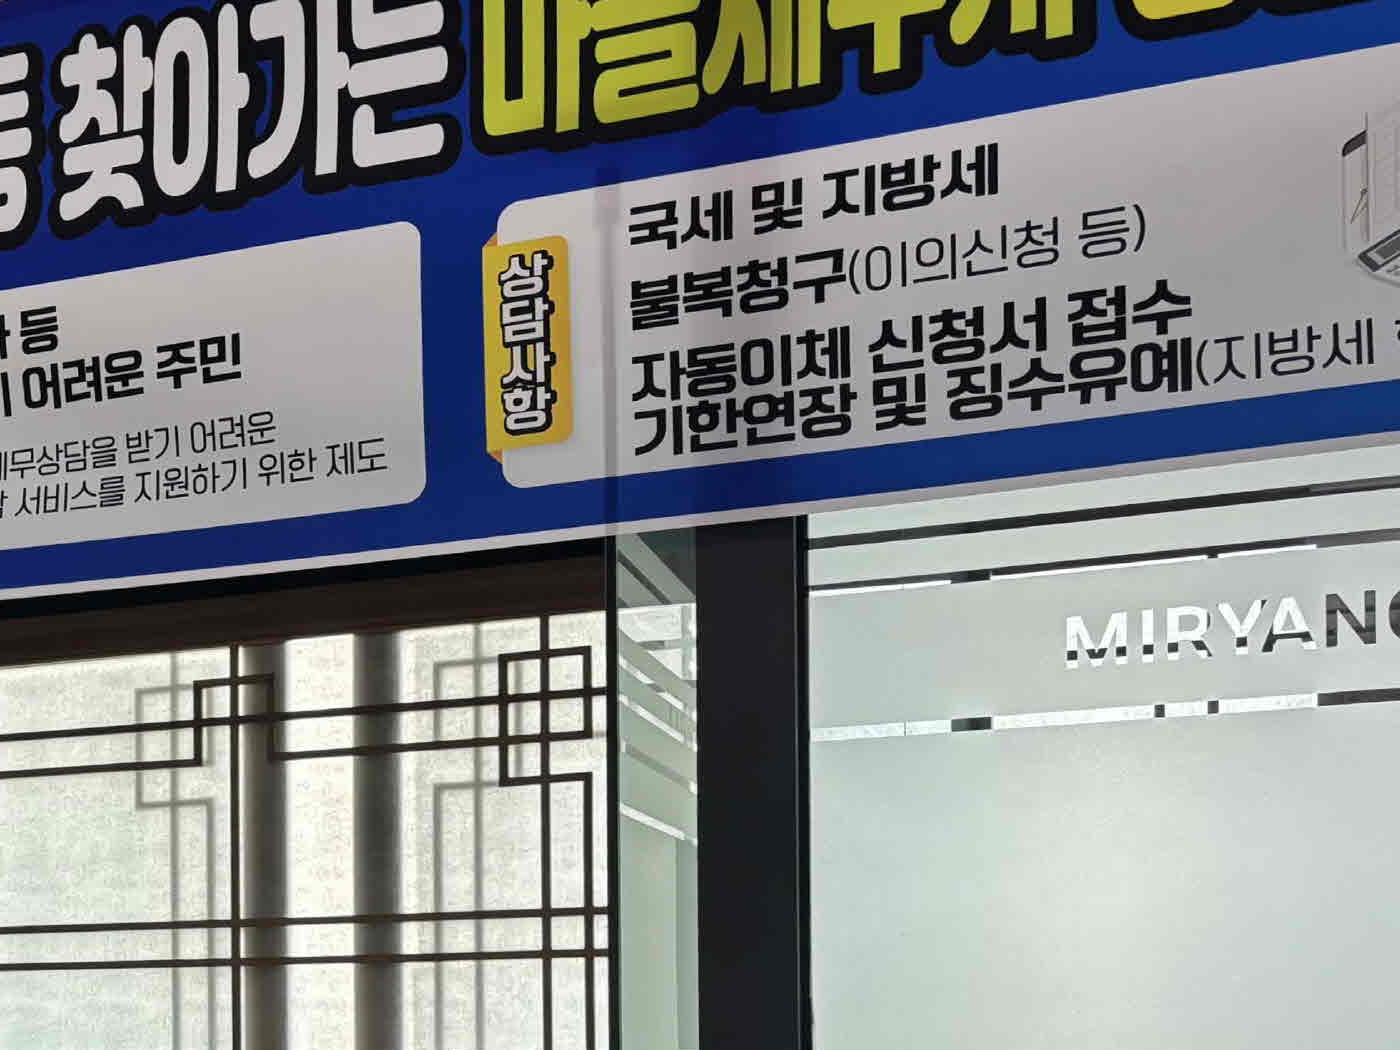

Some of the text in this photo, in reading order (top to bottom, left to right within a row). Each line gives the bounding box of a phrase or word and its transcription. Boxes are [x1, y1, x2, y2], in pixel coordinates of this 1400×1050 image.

[59, 0, 449, 221] 찾아가는
[628, 142, 1000, 251] 국세 및 지방세
[1078, 203, 1147, 257] 등)
[19, 306, 59, 353] 등
[499, 251, 554, 433] 상담사항
[631, 279, 1193, 400] 자동이체 신청서 접수
[23, 350, 143, 409] 어려운
[156, 332, 242, 388] 주민
[125, 424, 180, 463] 받기
[190, 411, 277, 451] 어려운
[634, 394, 856, 457] 기한연장
[875, 374, 927, 432] 및
[13, 474, 126, 517] 서비스를
[133, 459, 249, 503] 지원하기
[257, 449, 317, 486] 위한
[326, 436, 389, 475] 제도
[1065, 590, 1400, 669] MIRYAN
